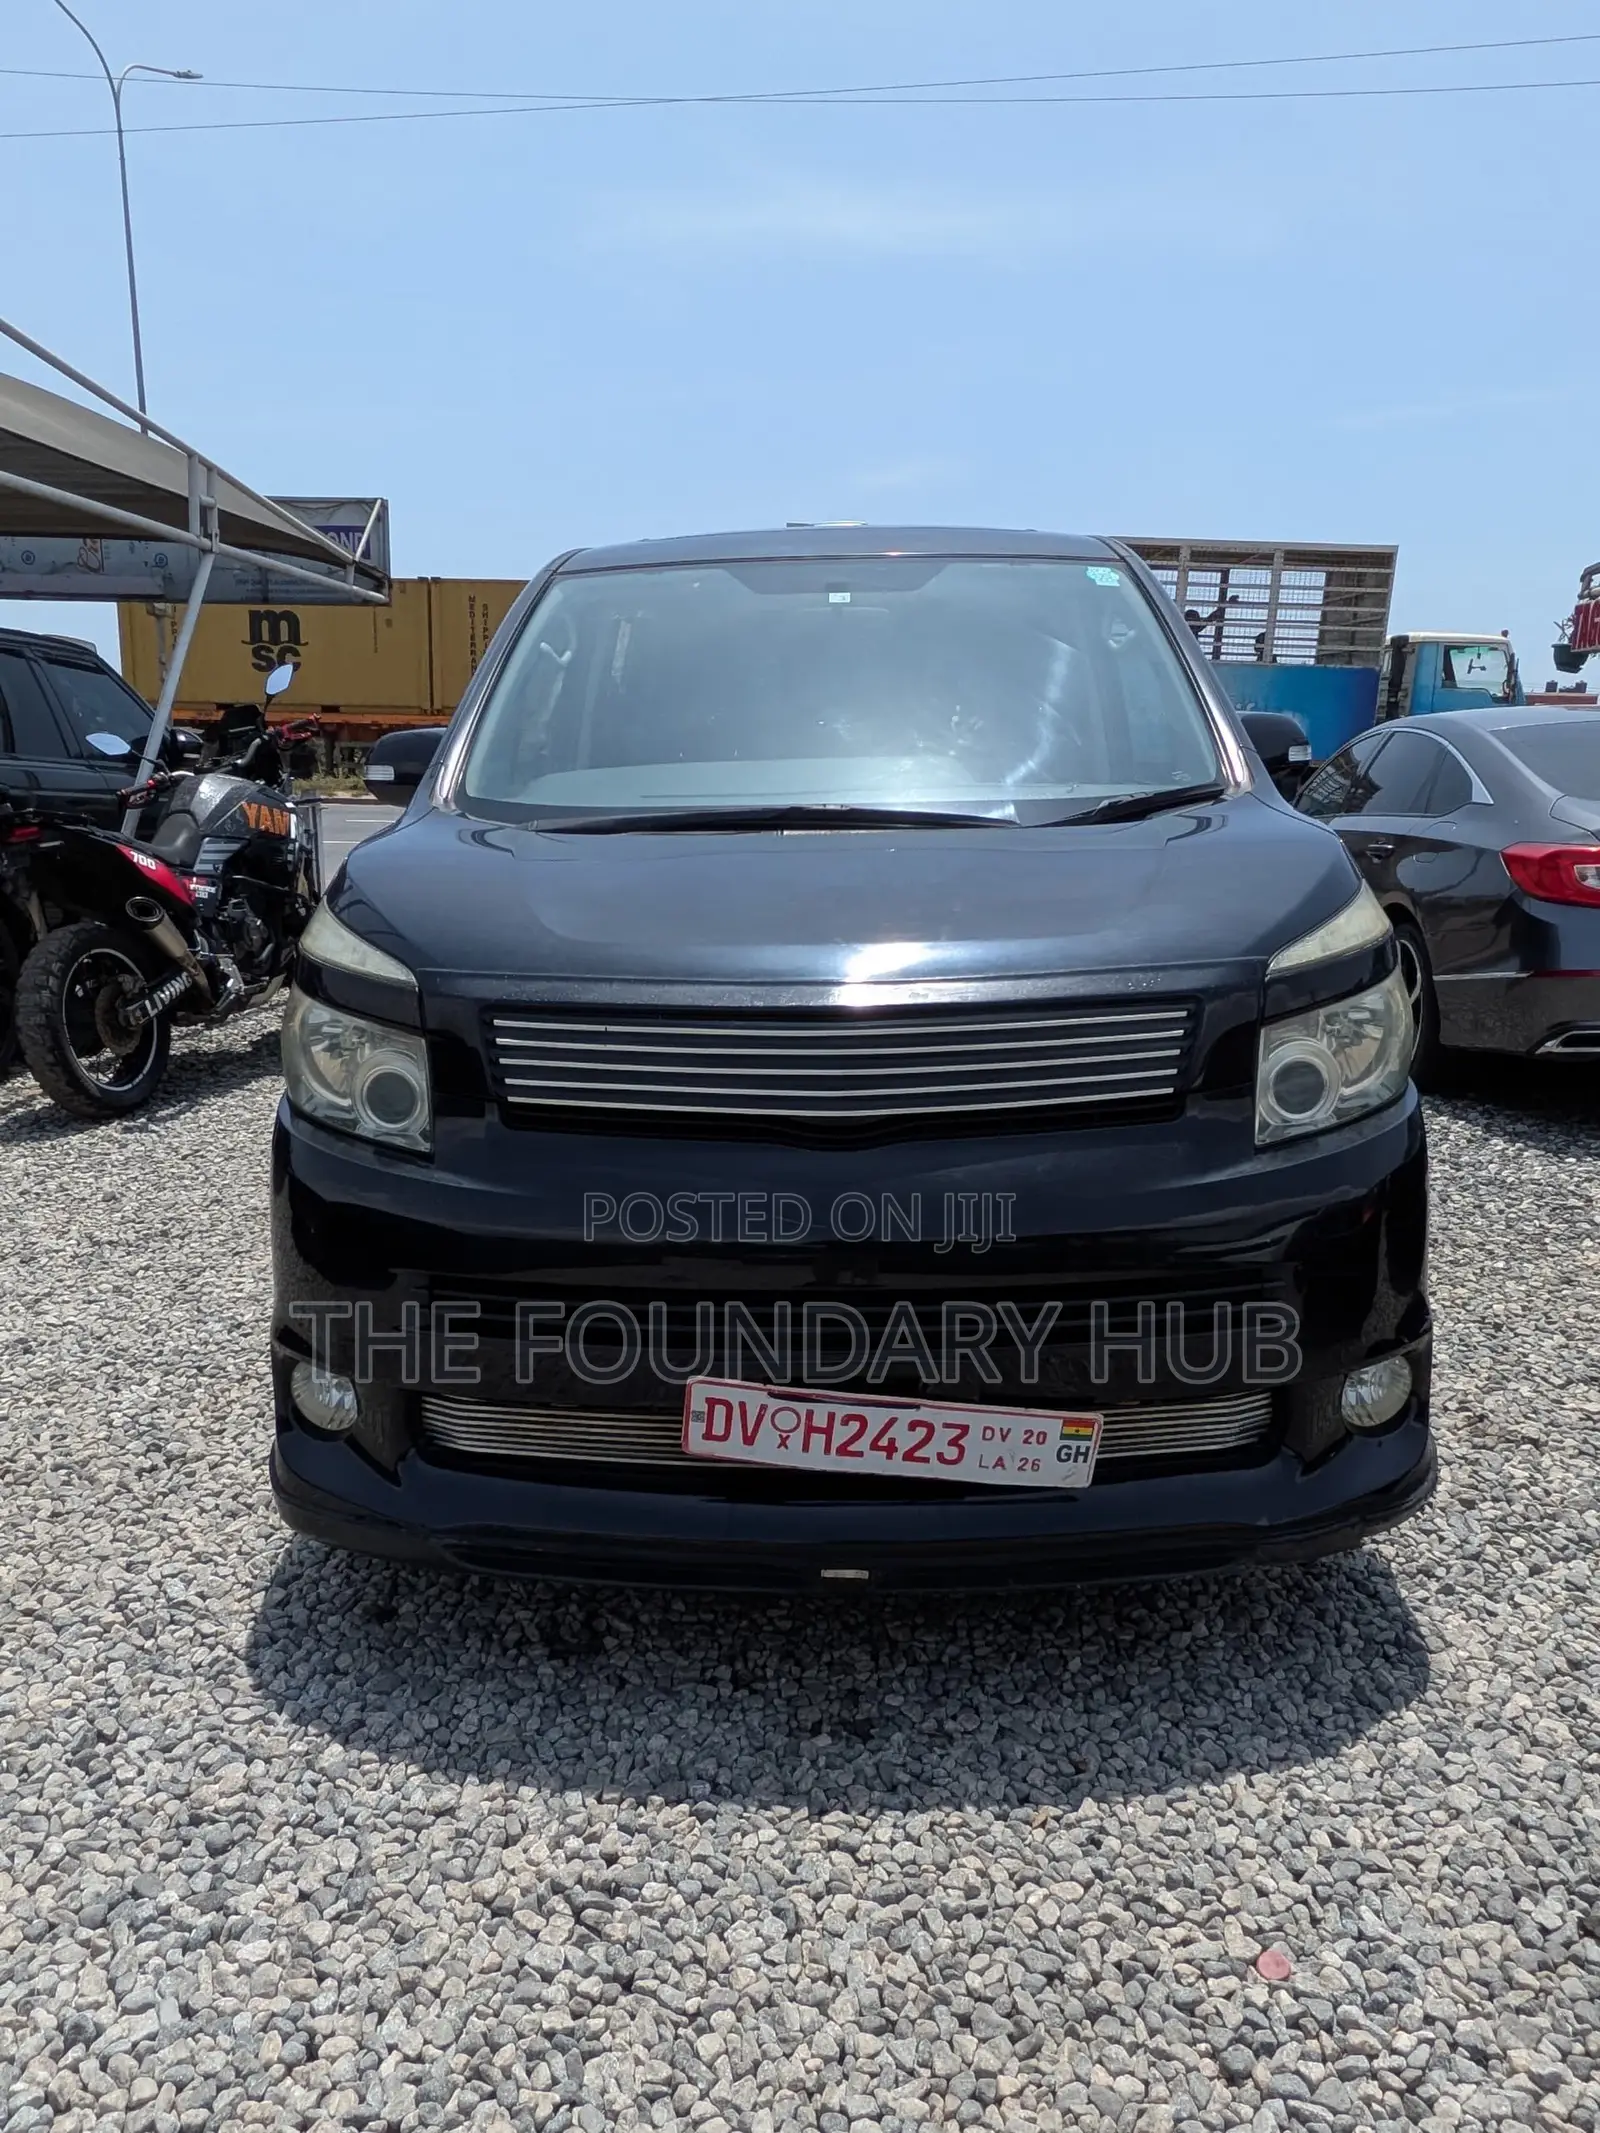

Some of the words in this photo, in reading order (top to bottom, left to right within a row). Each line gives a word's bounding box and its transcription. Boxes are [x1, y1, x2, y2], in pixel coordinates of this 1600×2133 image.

[129, 850, 157, 871] 700
[982, 1425, 1012, 1443] DV
[1022, 1428, 1048, 1446] 20
[978, 1453, 1006, 1471] LA
[1017, 1457, 1042, 1472] 26
[1055, 1444, 1091, 1464] GH
